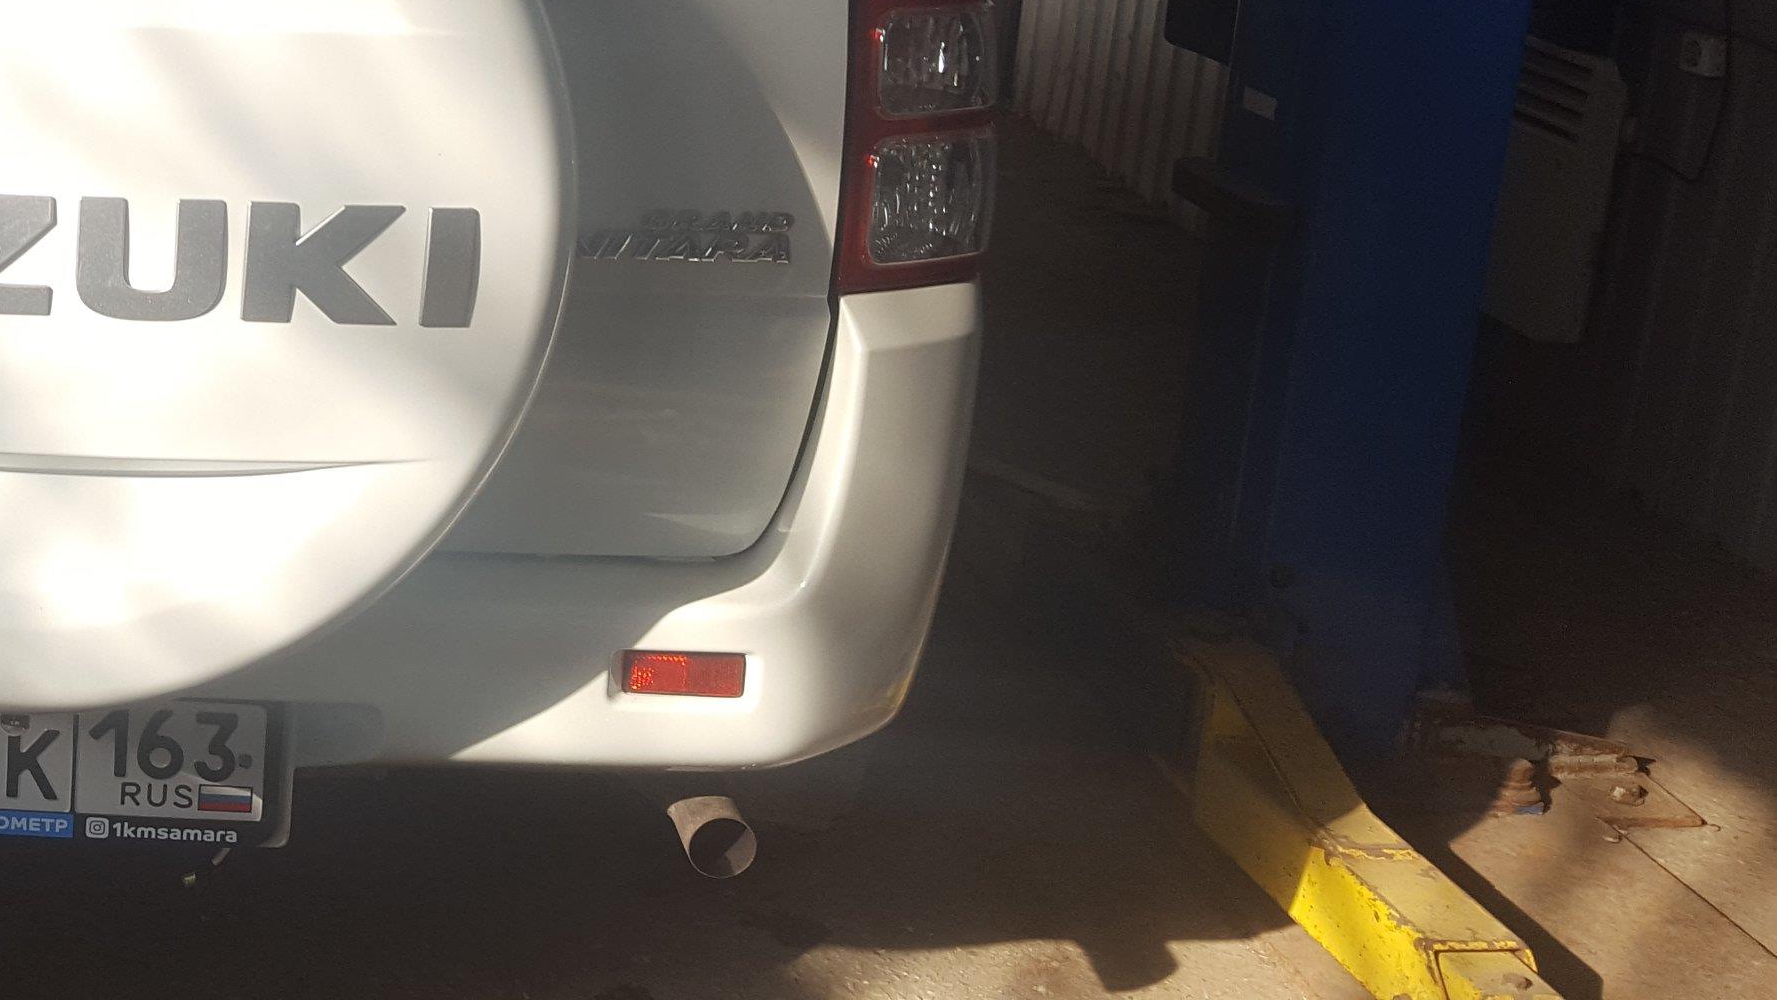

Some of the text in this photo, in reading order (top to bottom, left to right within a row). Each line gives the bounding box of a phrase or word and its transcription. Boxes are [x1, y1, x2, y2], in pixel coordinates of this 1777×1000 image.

[641, 209, 796, 232] GRAND
[577, 230, 792, 264] VITARA
[88, 709, 239, 783] 163
[120, 782, 194, 809] RUS
[112, 821, 238, 844] 1kmsamara
